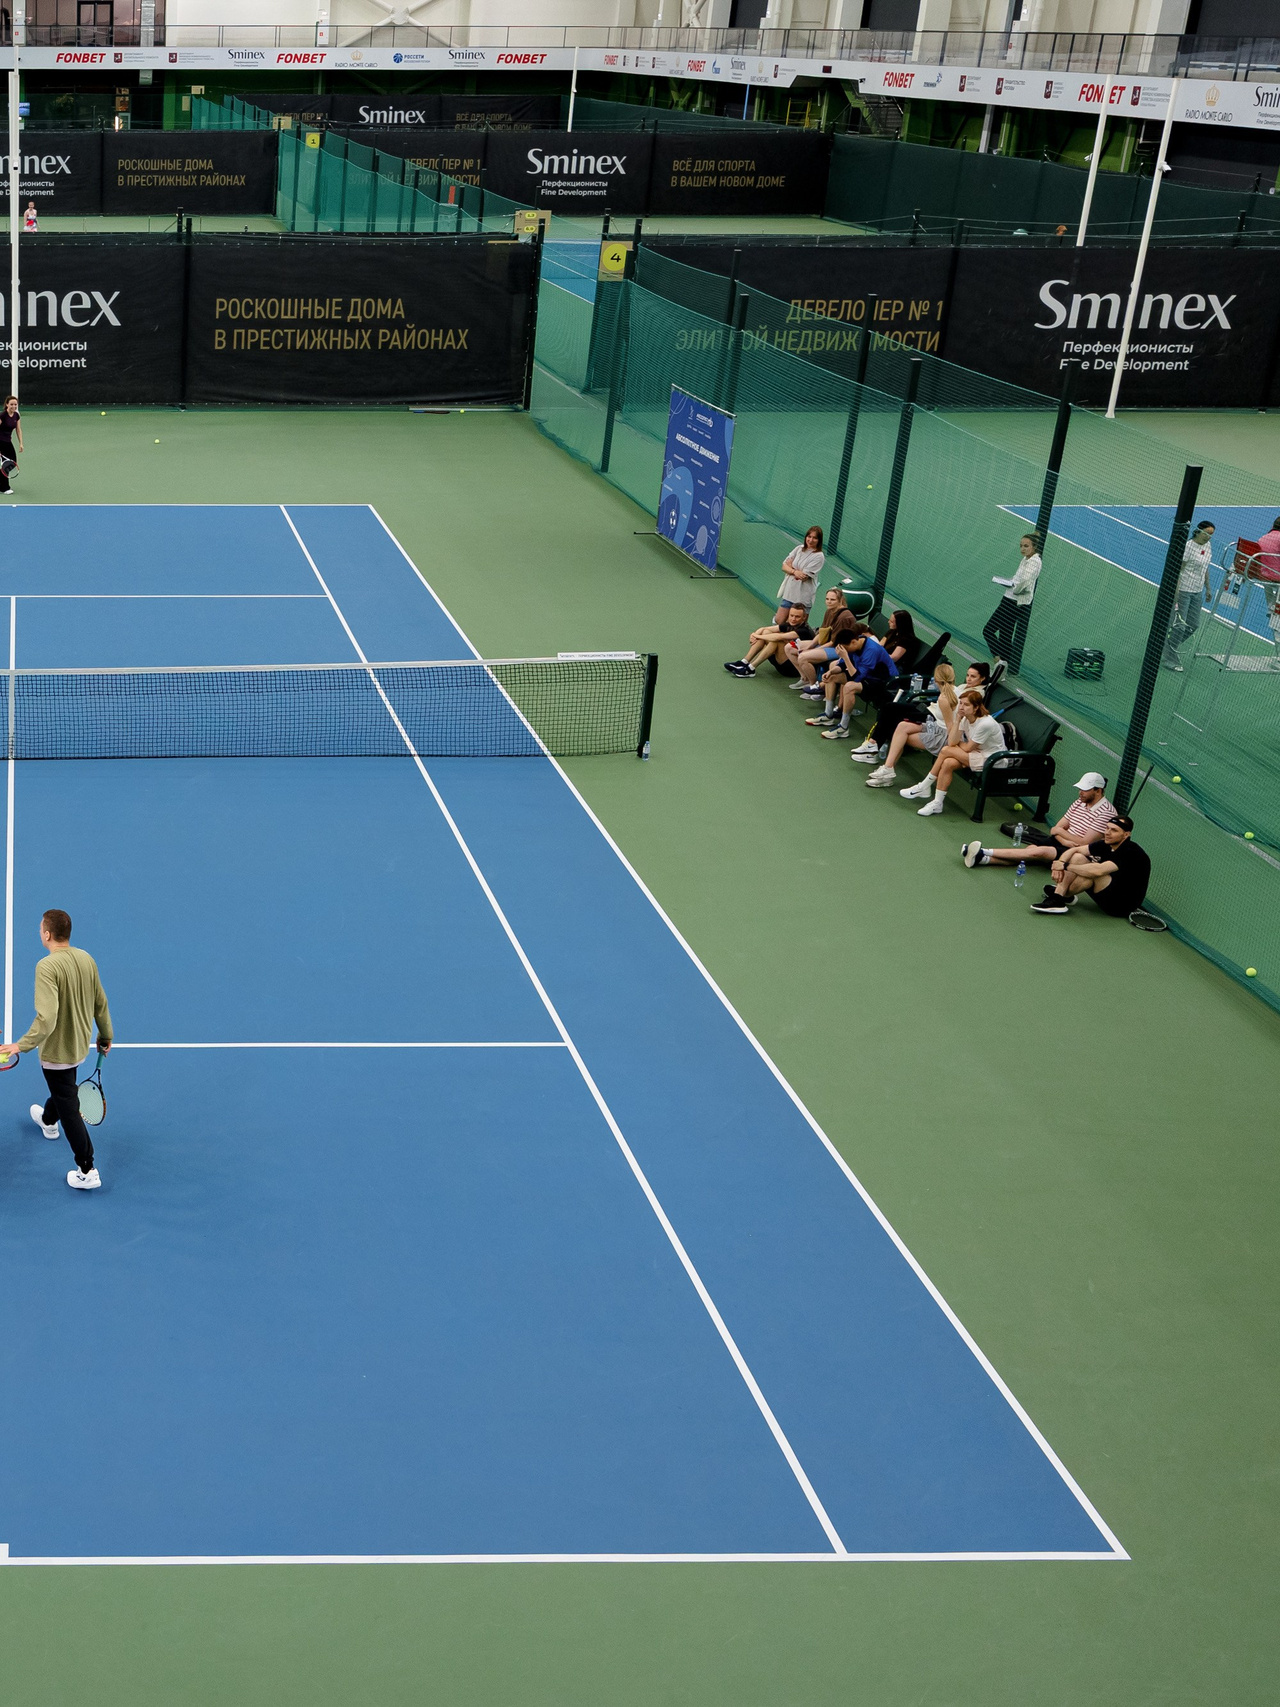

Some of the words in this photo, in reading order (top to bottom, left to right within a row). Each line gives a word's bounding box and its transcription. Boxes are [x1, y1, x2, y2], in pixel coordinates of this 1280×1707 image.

[56, 52, 106, 64] FONBET
[228, 48, 265, 60] Sminex
[276, 53, 327, 64] FONBET
[448, 49, 486, 60] Sminex
[496, 53, 548, 64] FONBET
[687, 59, 706, 73] FONBET
[883, 71, 915, 89] FONBET
[1078, 83, 1126, 105] FONET
[358, 105, 426, 124] Sminex
[1185, 109, 1200, 119] RADIO
[1201, 110, 1217, 120] MONTE
[1217, 111, 1233, 122] CARLO
[118, 159, 182, 171] РОСКОШНЫЕ
[184, 159, 213, 172] ДОМА
[463, 158, 474, 170] №
[476, 158, 481, 170] 1
[526, 148, 627, 175] Sminex
[672, 157, 692, 172] ВСЁ
[693, 159, 715, 173] ДЛЯ
[718, 159, 756, 172] СПОРТА
[117, 175, 124, 186] В
[127, 175, 197, 187] ПРЕСТИЖНЫХ
[200, 172, 246, 186] РАЙОНАХ
[541, 180, 609, 188] Перфекционисты
[670, 176, 678, 187] В
[680, 176, 717, 187] ВАШЕМ
[719, 176, 755, 187] НОВОМ
[756, 176, 786, 188] ДОМЕ
[5, 188, 54, 197] Delopment
[558, 188, 607, 197] Development
[610, 252, 621, 263] 4
[215, 298, 343, 319] РОСКОШНЫЕ
[347, 298, 405, 323] ДОМА
[908, 299, 930, 321] №
[935, 299, 944, 321] 1
[1034, 279, 1237, 330] Smnex
[214, 329, 226, 350] В
[233, 329, 372, 350] ПРЕСТИЖНЫХ
[378, 324, 469, 350] РАЙОНАХ
[774, 329, 941, 354] НЕДВИЖМОСТИ
[1059, 358, 1090, 370] Fe
